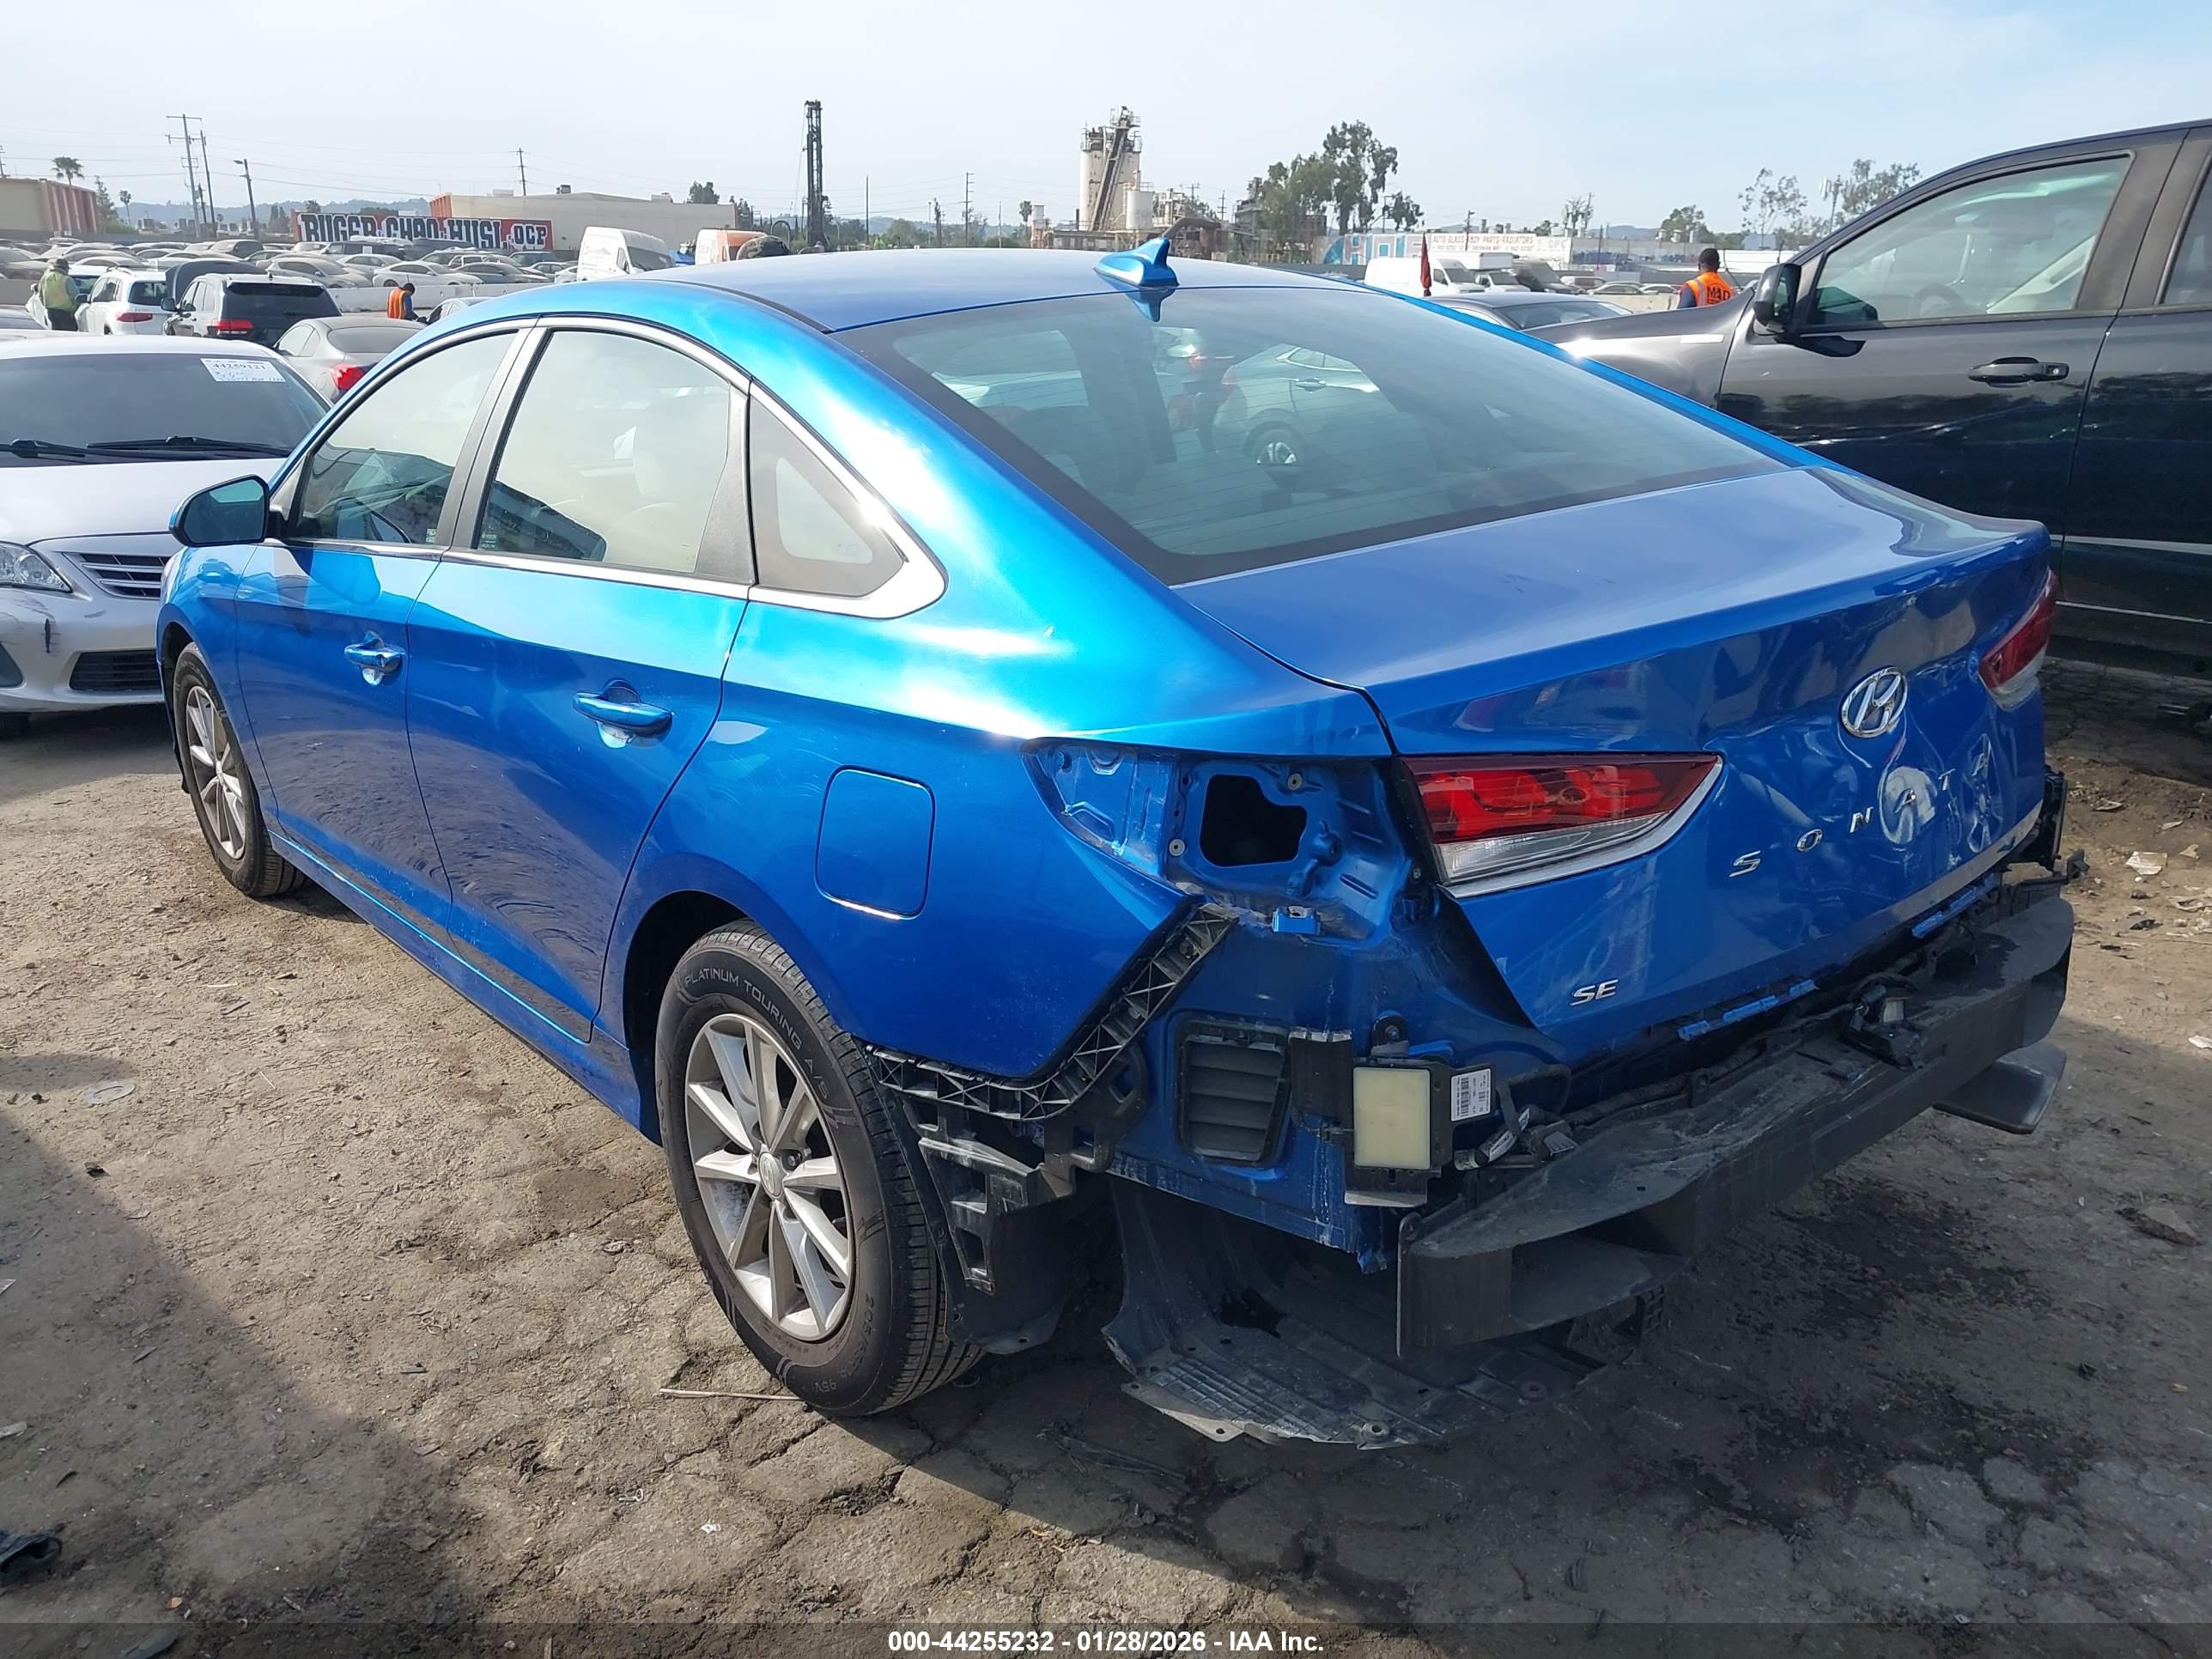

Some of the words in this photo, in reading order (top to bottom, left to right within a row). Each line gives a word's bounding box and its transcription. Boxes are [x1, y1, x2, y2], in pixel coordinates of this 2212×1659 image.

[512, 223, 548, 247] OCP
[1729, 750, 1993, 878] SONATA
[1569, 978, 1619, 1007] SE
[684, 968, 740, 988] PLATINUM
[744, 979, 803, 1050] TOURING
[804, 1058, 830, 1099] A/S
